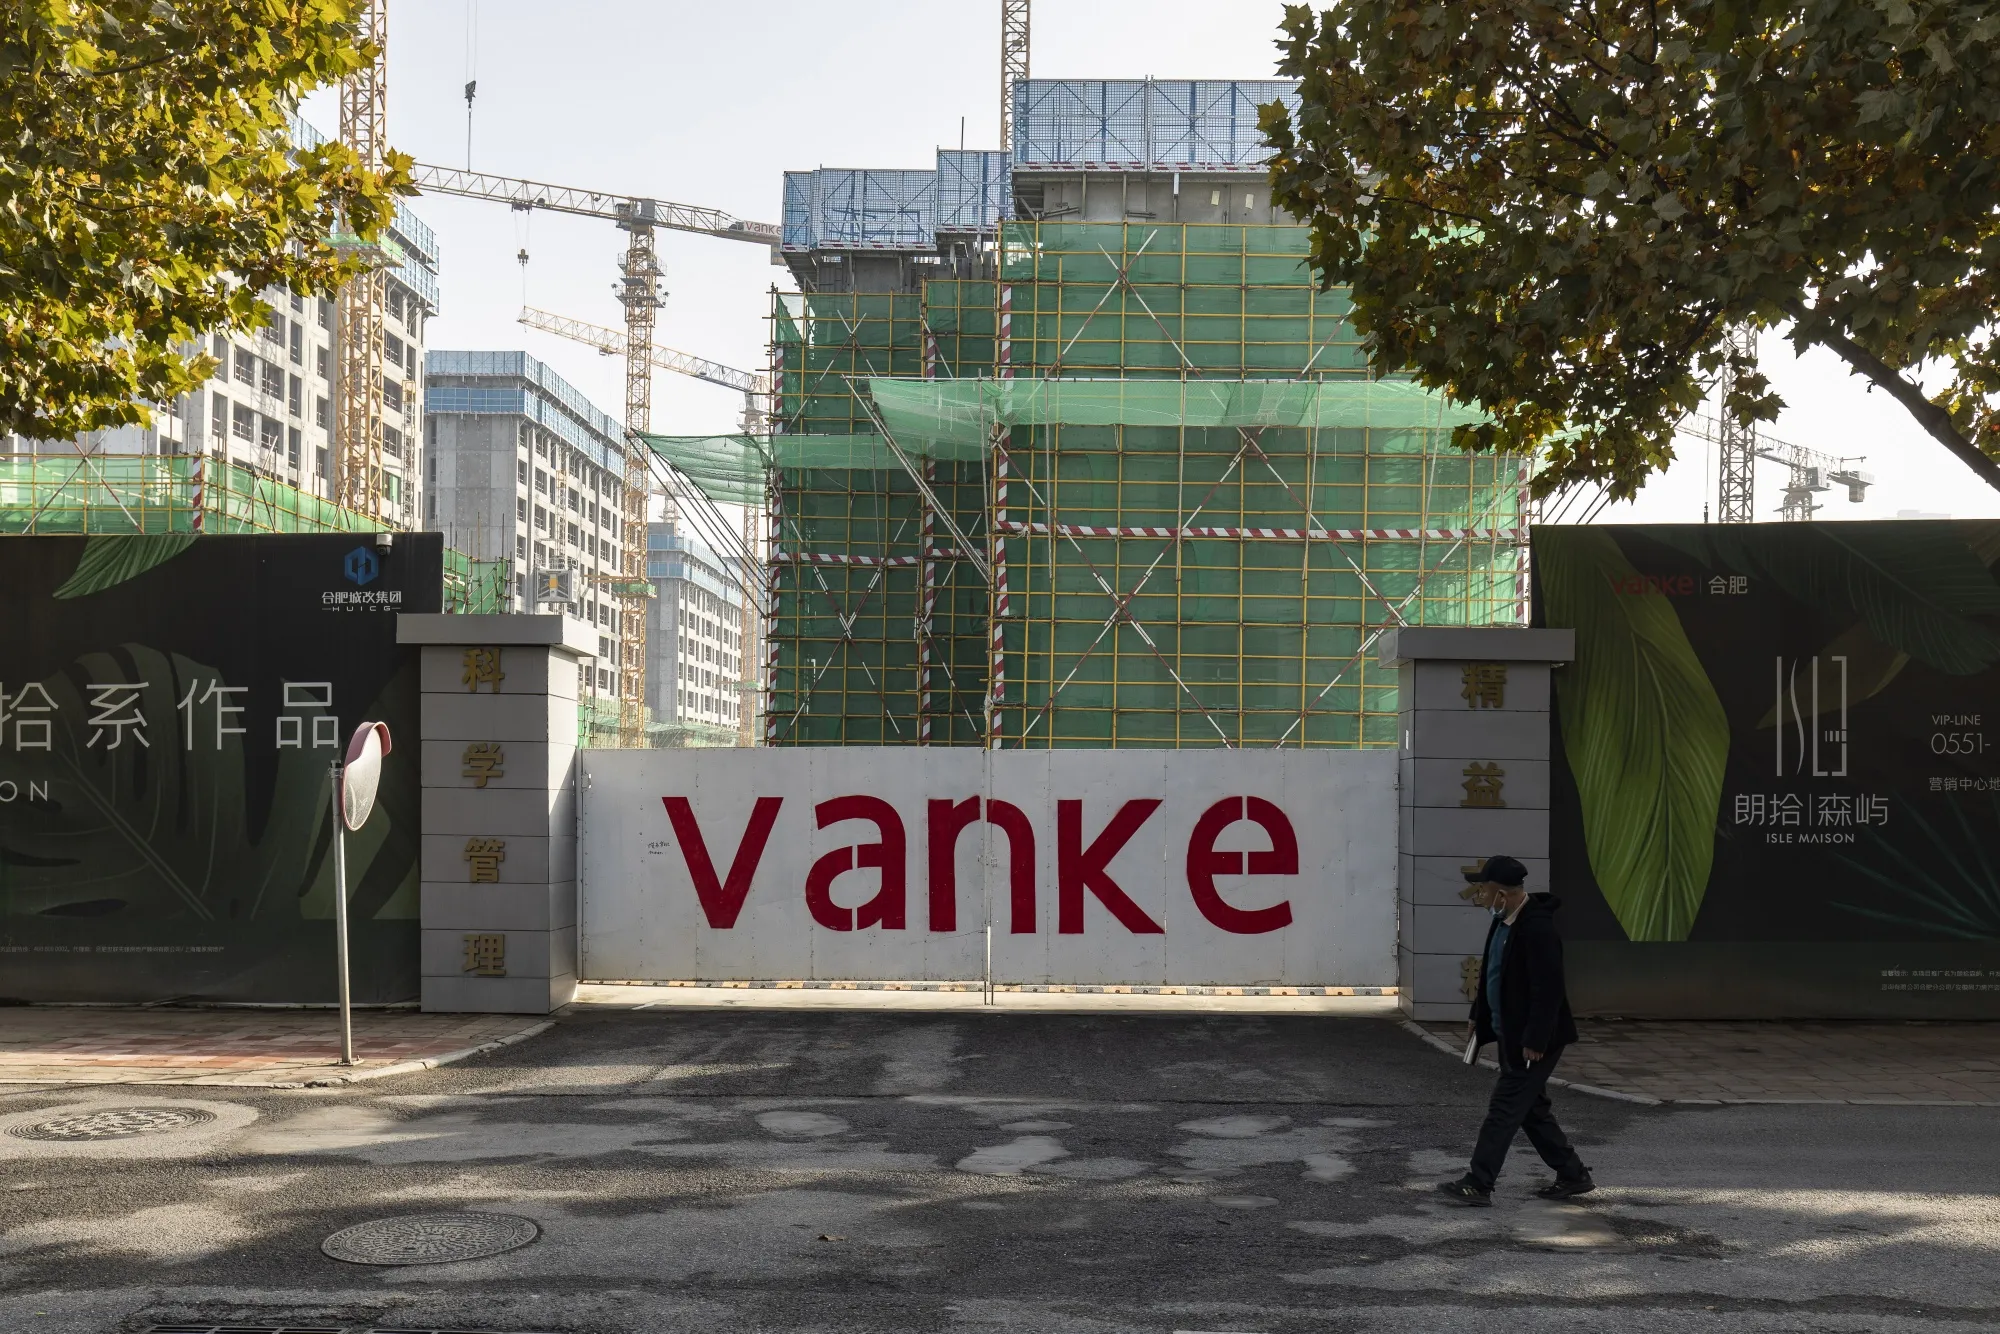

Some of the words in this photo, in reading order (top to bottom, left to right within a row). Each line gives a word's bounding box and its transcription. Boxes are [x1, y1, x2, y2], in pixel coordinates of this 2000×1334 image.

[1708, 575, 1748, 595] 合肥
[321, 590, 402, 604] 合肥城改集团
[1931, 714, 1981, 726] VIP-LINE
[462, 647, 506, 976] 科学管理
[1766, 833, 1793, 844] ISLE
[1798, 833, 1854, 844] MAISON
[661, 795, 1299, 934] vanke
